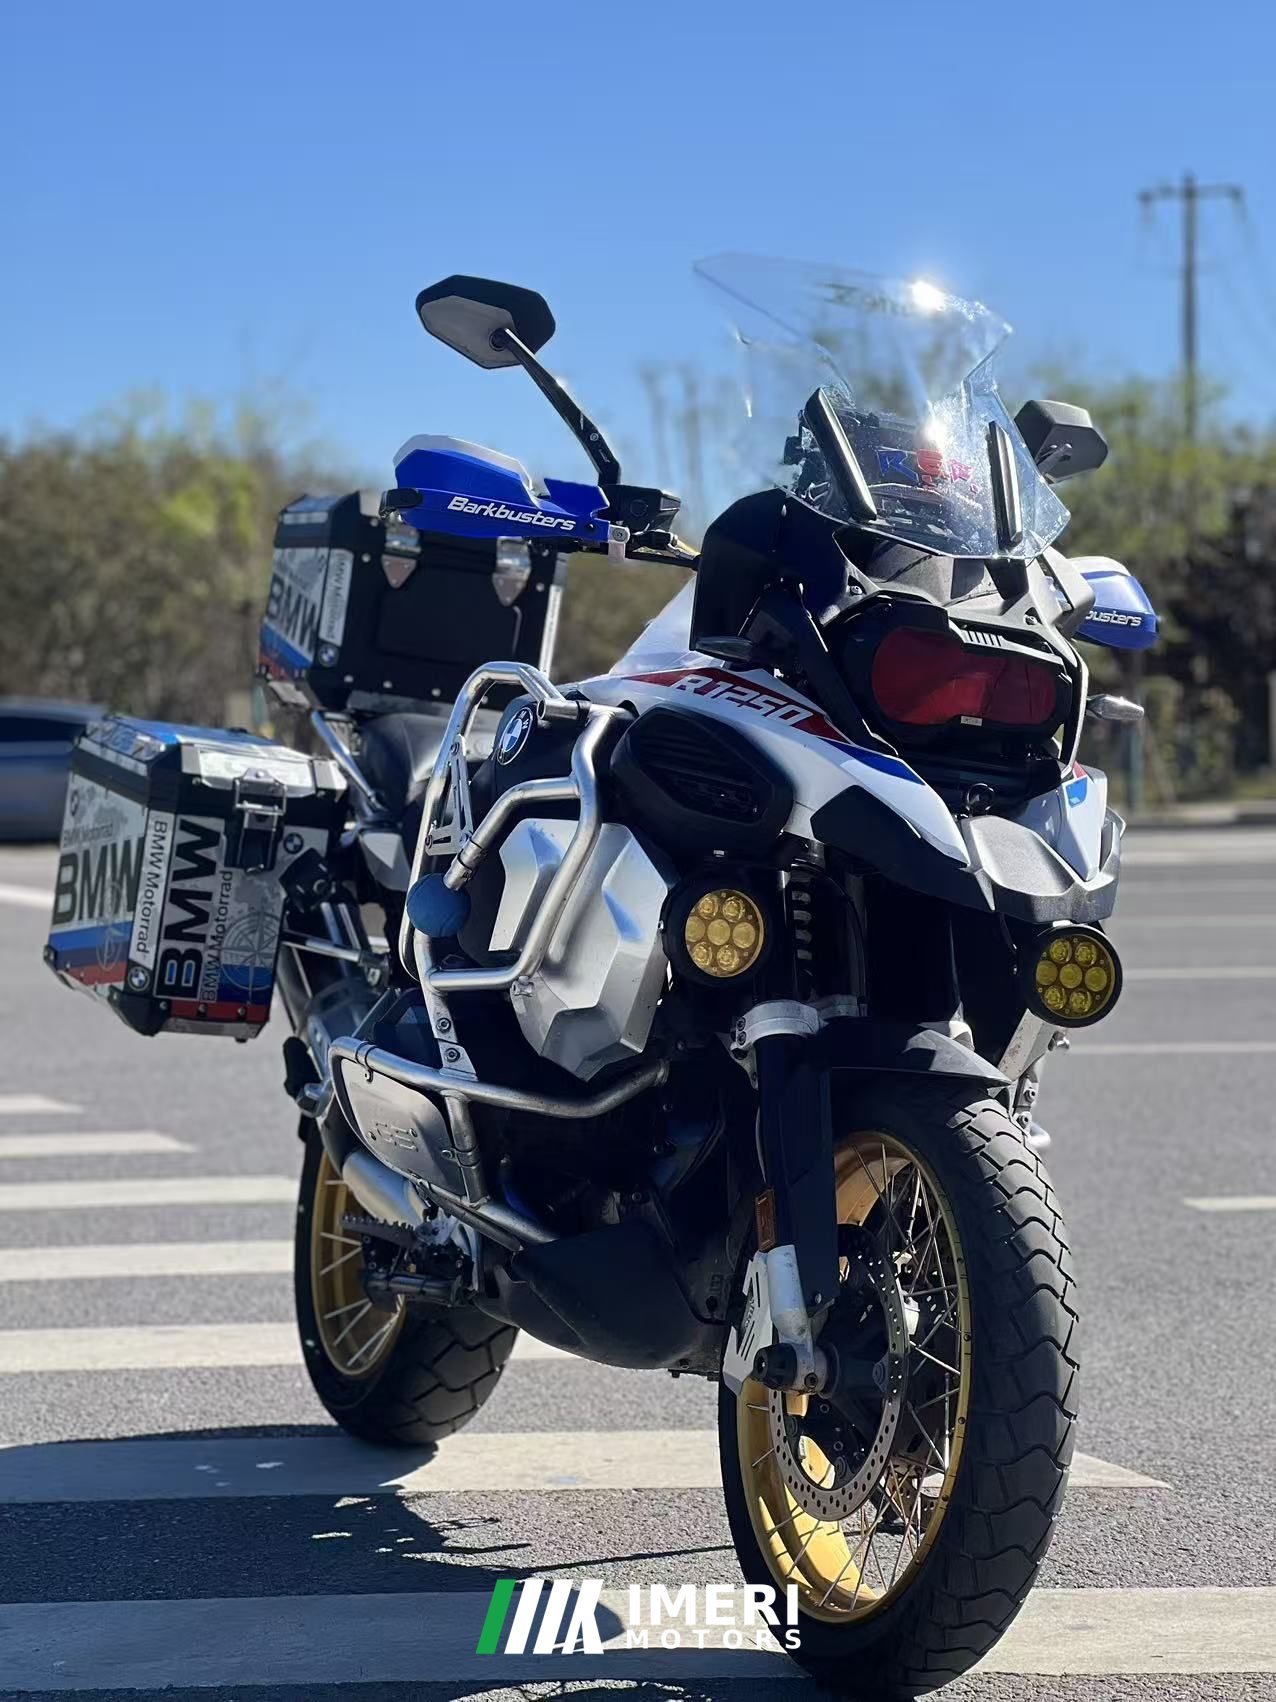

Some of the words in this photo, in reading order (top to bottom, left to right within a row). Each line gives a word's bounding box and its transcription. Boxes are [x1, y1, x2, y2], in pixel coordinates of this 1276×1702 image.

[447, 496, 576, 531] Barkbusters
[266, 573, 316, 653] BMW
[671, 673, 814, 727] R1250
[51, 836, 147, 926] BMW
[147, 820, 168, 876] BMW
[137, 876, 162, 954] Motorrad
[162, 819, 221, 996] BMW
[211, 870, 234, 947] Motorrad
[203, 952, 220, 1000] BMW
